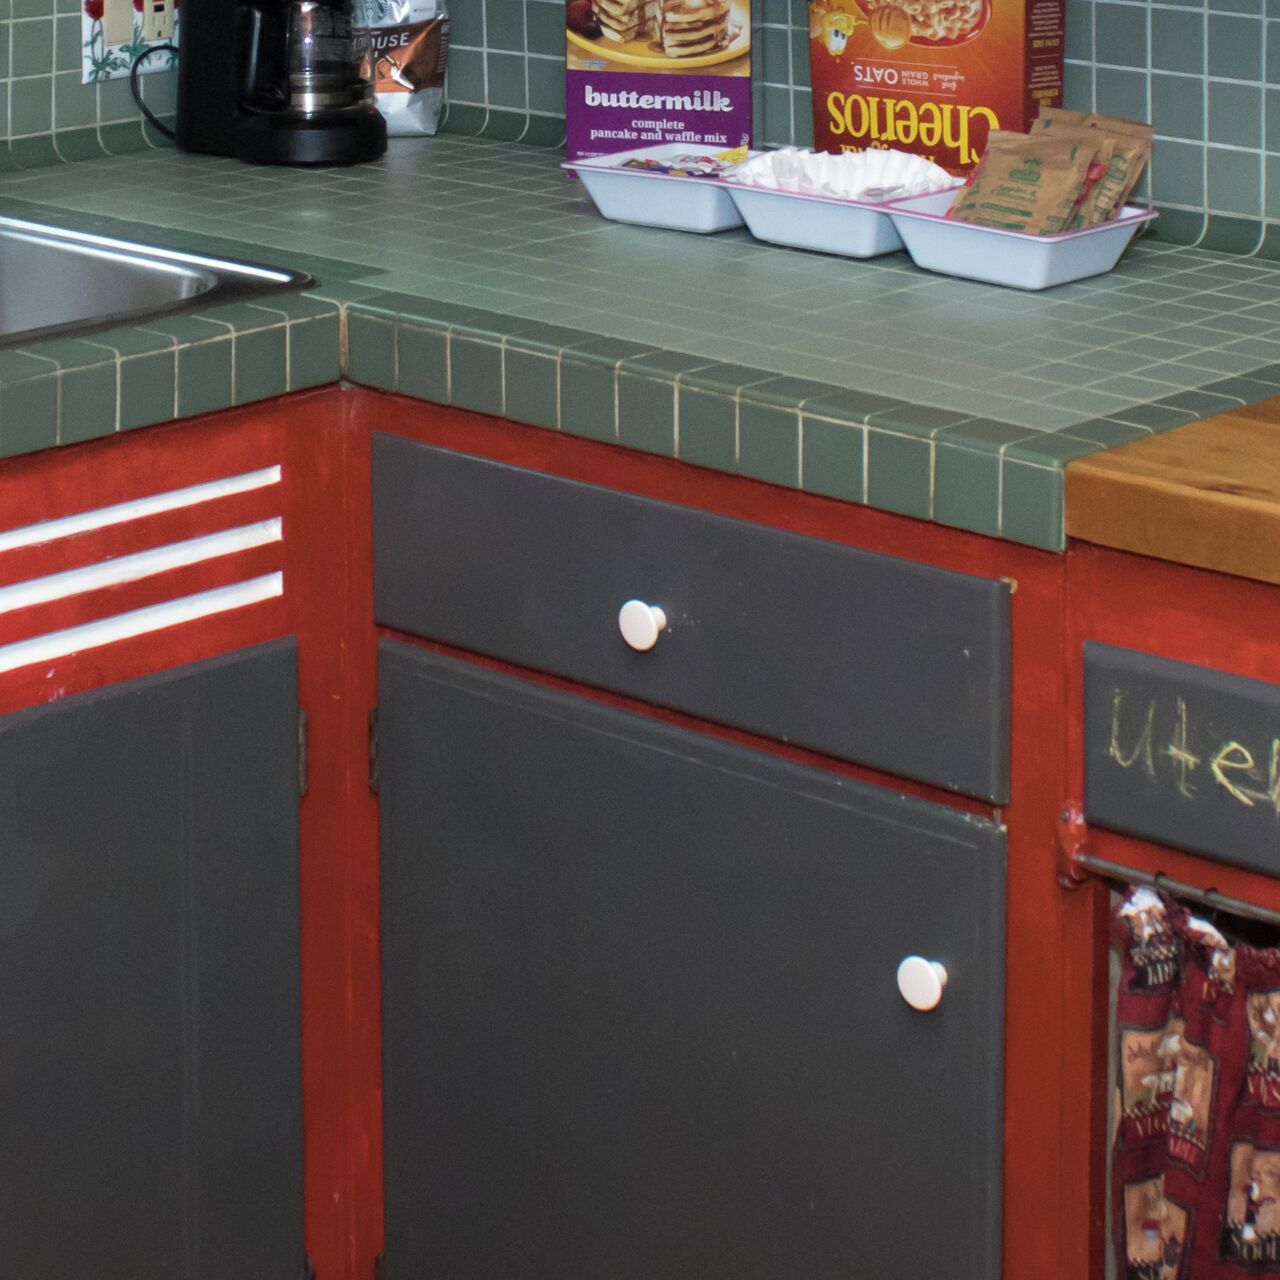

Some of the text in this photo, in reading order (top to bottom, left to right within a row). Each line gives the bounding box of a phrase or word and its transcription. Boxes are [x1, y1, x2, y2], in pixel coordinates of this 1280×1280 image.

[853, 65, 899, 85] OATS
[901, 70, 929, 79] GRAIN
[901, 79, 929, 87] WHOLE
[584, 85, 734, 113] buttermilk
[631, 118, 685, 131] complete
[825, 90, 1000, 164] Cheerios
[590, 129, 728, 144] pancake and waffle mix
